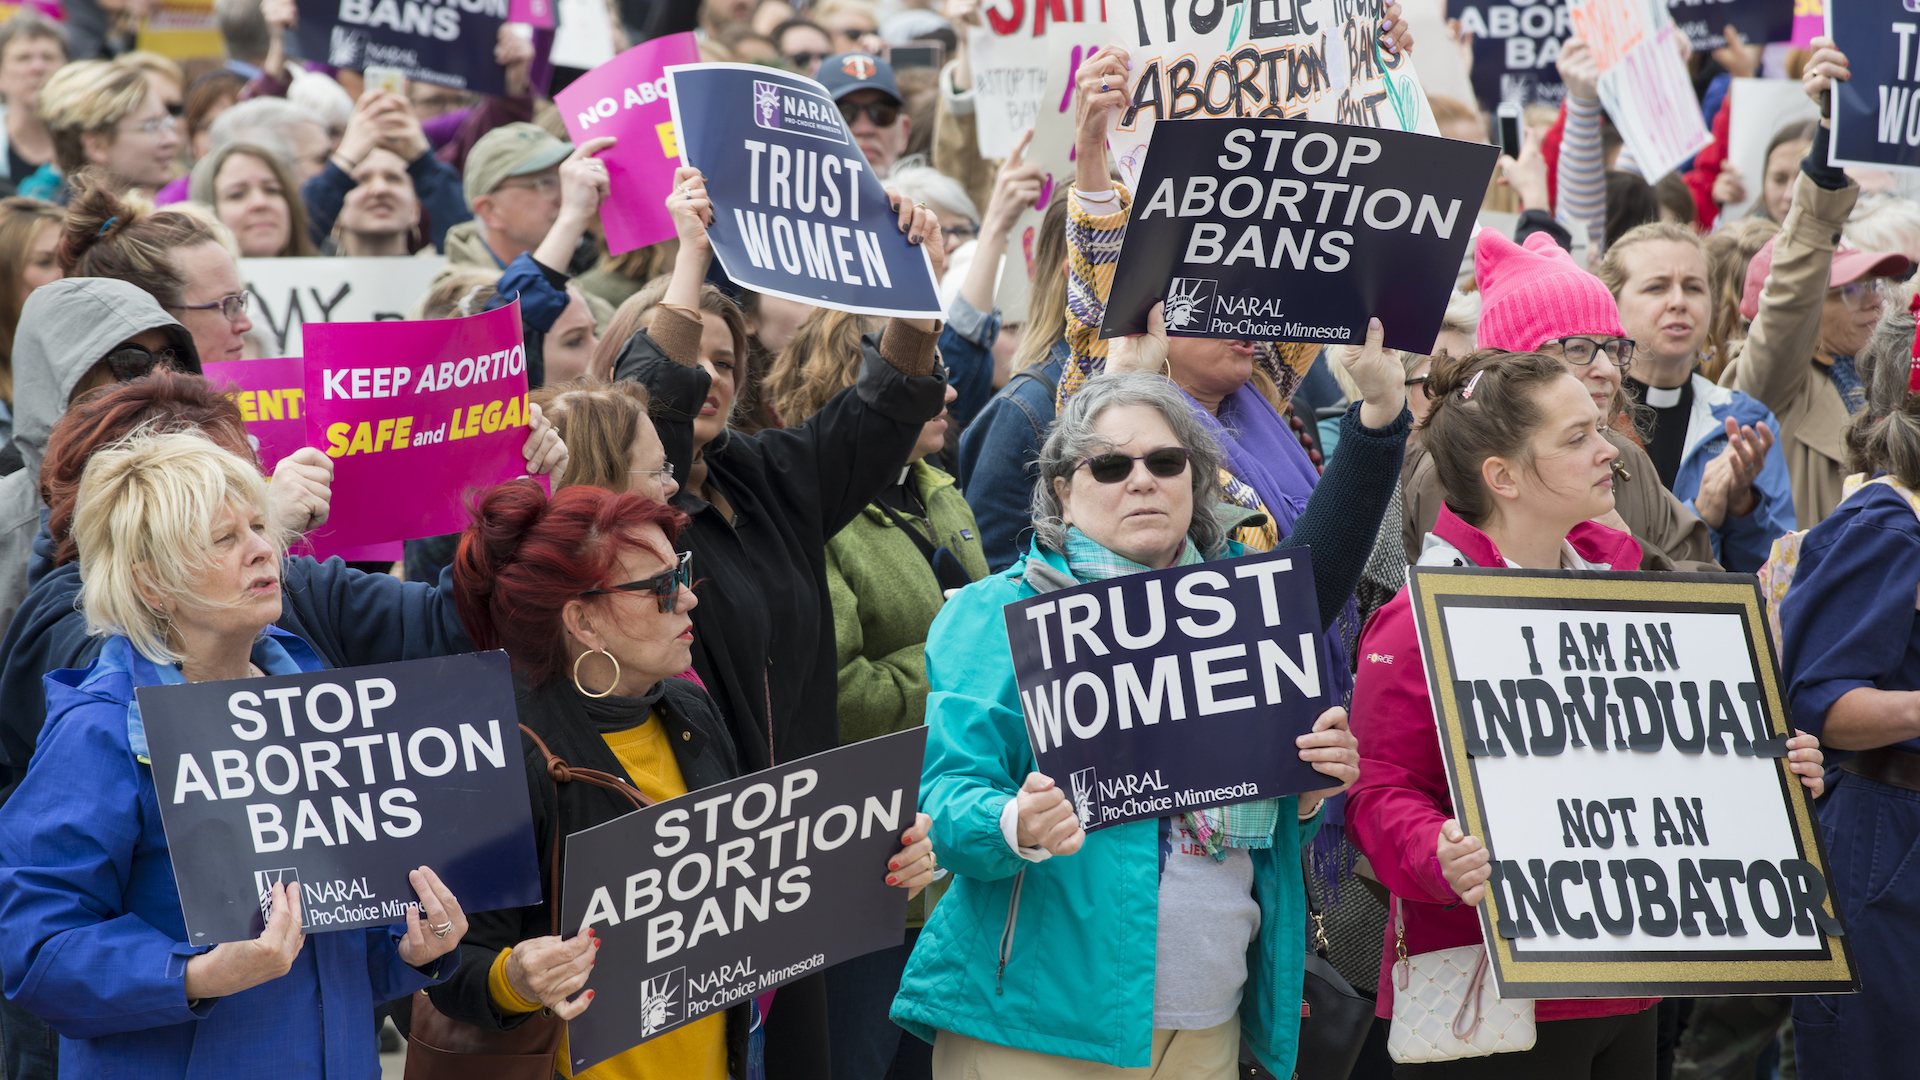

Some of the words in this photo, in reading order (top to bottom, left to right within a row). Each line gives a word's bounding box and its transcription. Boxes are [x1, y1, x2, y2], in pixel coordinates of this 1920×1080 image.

[338, 0, 461, 42] BANS
[1121, 45, 1330, 126] ABORTION
[1344, 18, 1401, 86] BANS
[577, 97, 618, 130] NO
[784, 95, 840, 127] NARAL
[784, 117, 816, 130] PRO-CHOICE
[816, 123, 842, 135] MINNESOTA
[1218, 128, 1382, 178] STOP
[744, 139, 863, 221] TRUST
[1139, 176, 1462, 240] ABORTION
[734, 209, 892, 289] WOMEN
[1183, 222, 1355, 273] BANS
[1210, 319, 1282, 337] Pro-Choice
[1285, 322, 1351, 340] Minnesota
[1215, 295, 1284, 318] NARAL
[323, 366, 411, 400] KEEP
[325, 416, 414, 459] SAFE
[413, 423, 446, 447] and
[449, 391, 531, 441] LEGAL
[1025, 557, 1293, 670] TRUST
[1366, 652, 1394, 665] FORCE
[1521, 626, 1543, 675] I
[1558, 621, 1618, 672] AM
[1624, 621, 1681, 672] AN
[228, 677, 396, 741] STOP
[1021, 632, 1322, 754] WOMEN
[1453, 676, 1789, 759] INDIVIDUAL
[173, 720, 506, 804] ABORTION
[1098, 769, 1169, 802] NARAL
[246, 788, 423, 854] BANS
[653, 768, 818, 858] STOP
[1101, 797, 1172, 822] Pro-Choice
[1174, 780, 1259, 808] Minnesota
[1557, 797, 1639, 850] NOT
[1652, 797, 1710, 848] AN
[577, 788, 903, 933] ABORTION
[1181, 843, 1207, 857] LIES
[303, 877, 375, 905] NARAL
[309, 904, 380, 926] Pro-Choice
[647, 865, 812, 963] BANS
[1490, 858, 1846, 939] INCUBATOR
[687, 979, 757, 1018] Pro-Choice
[758, 953, 825, 989] Minnesota
[688, 956, 757, 998] NARAL
